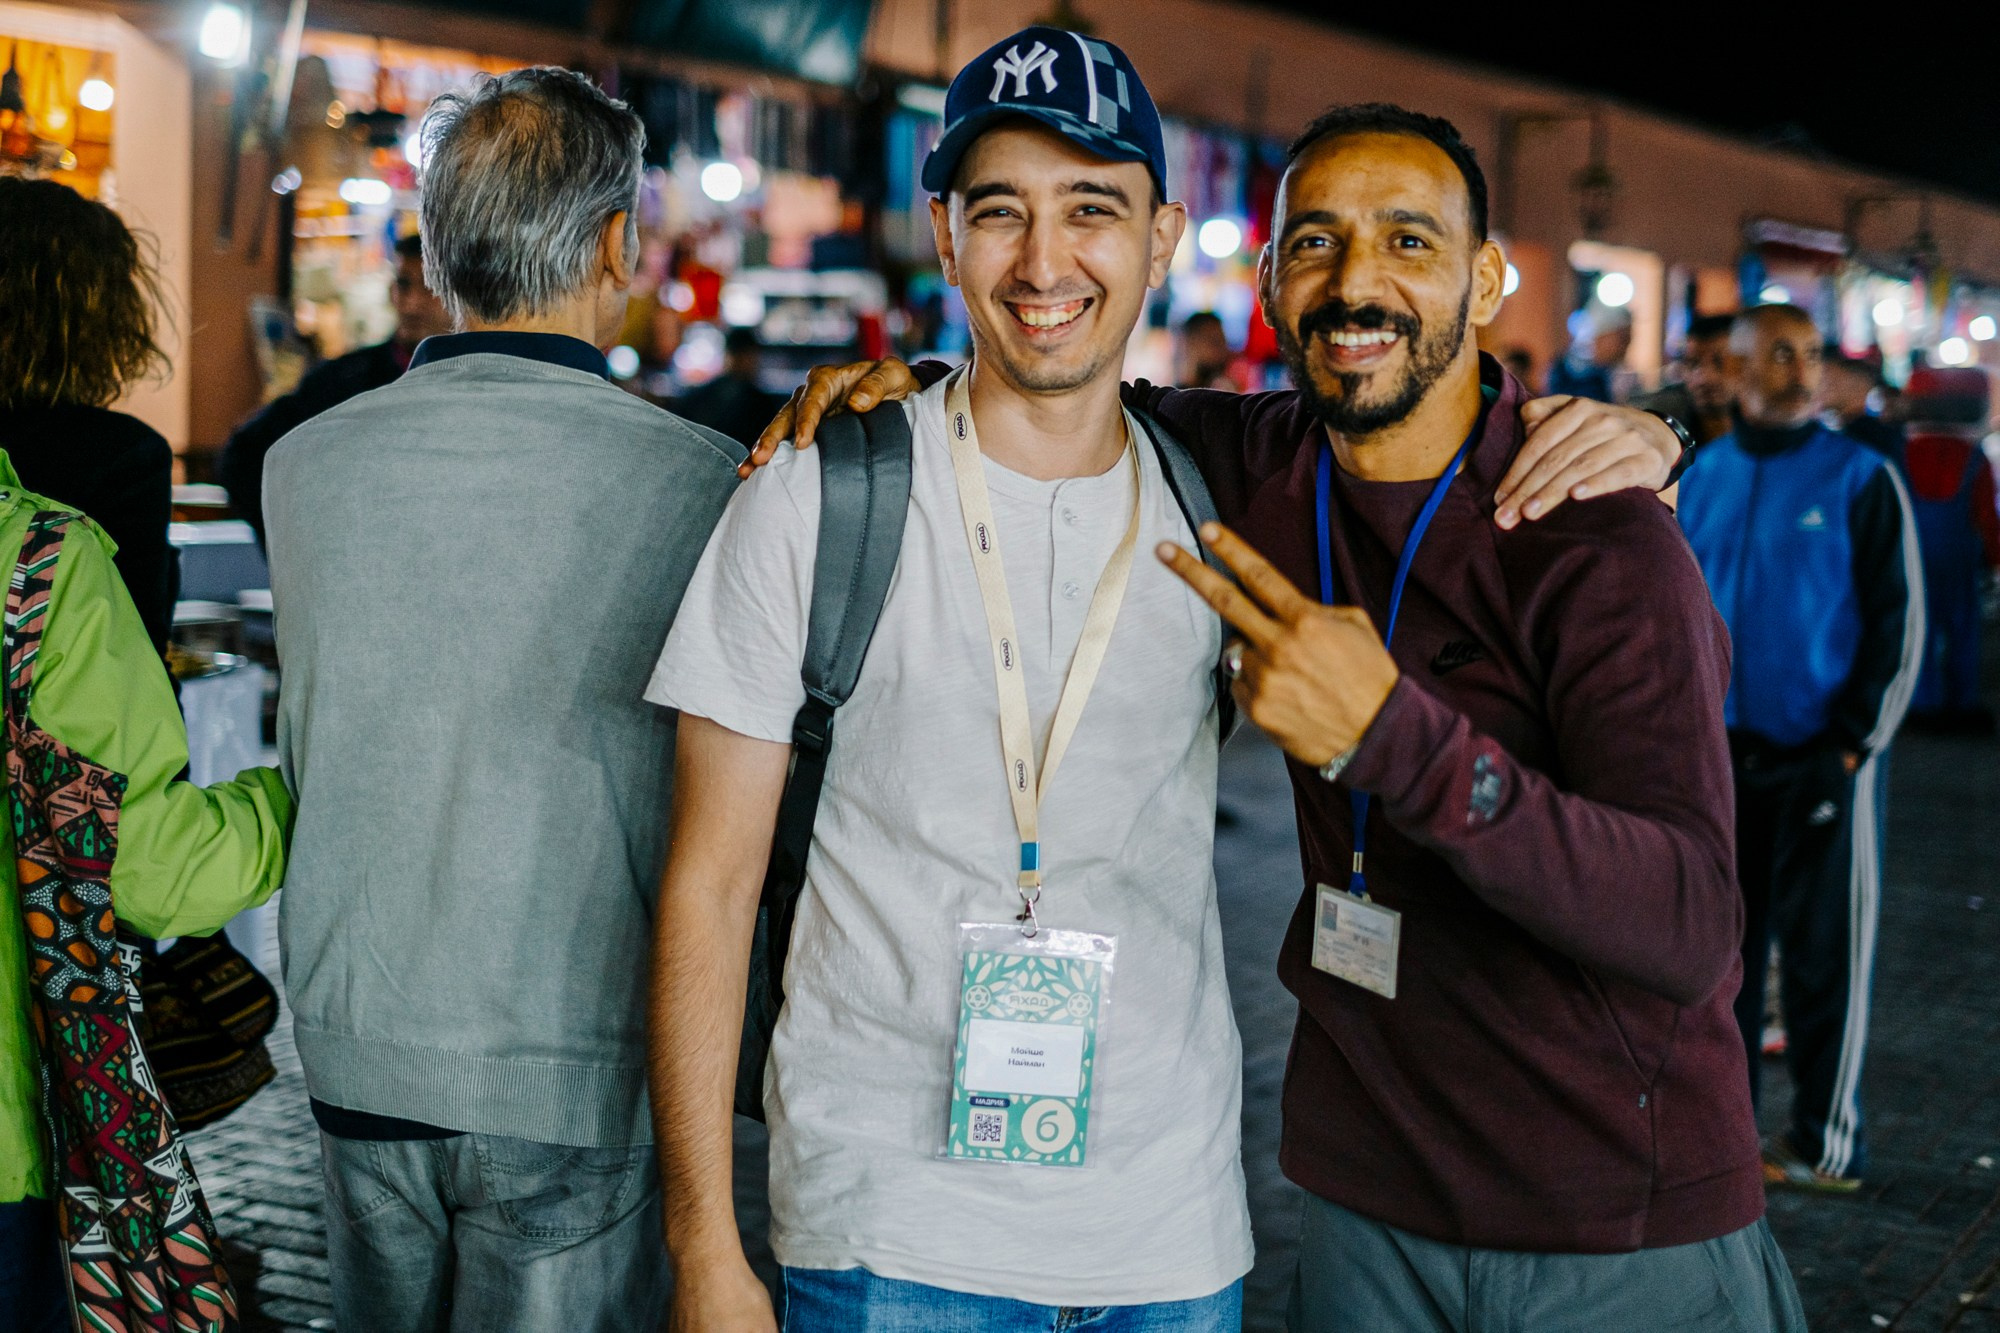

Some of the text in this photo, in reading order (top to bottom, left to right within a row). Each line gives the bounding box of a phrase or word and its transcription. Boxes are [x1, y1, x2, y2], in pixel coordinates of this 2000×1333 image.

[989, 41, 1059, 103] NY
[1009, 995, 1049, 1007] ЯХАД
[1008, 1058, 1045, 1068] Найман
[1036, 1110, 1060, 1143] 6
